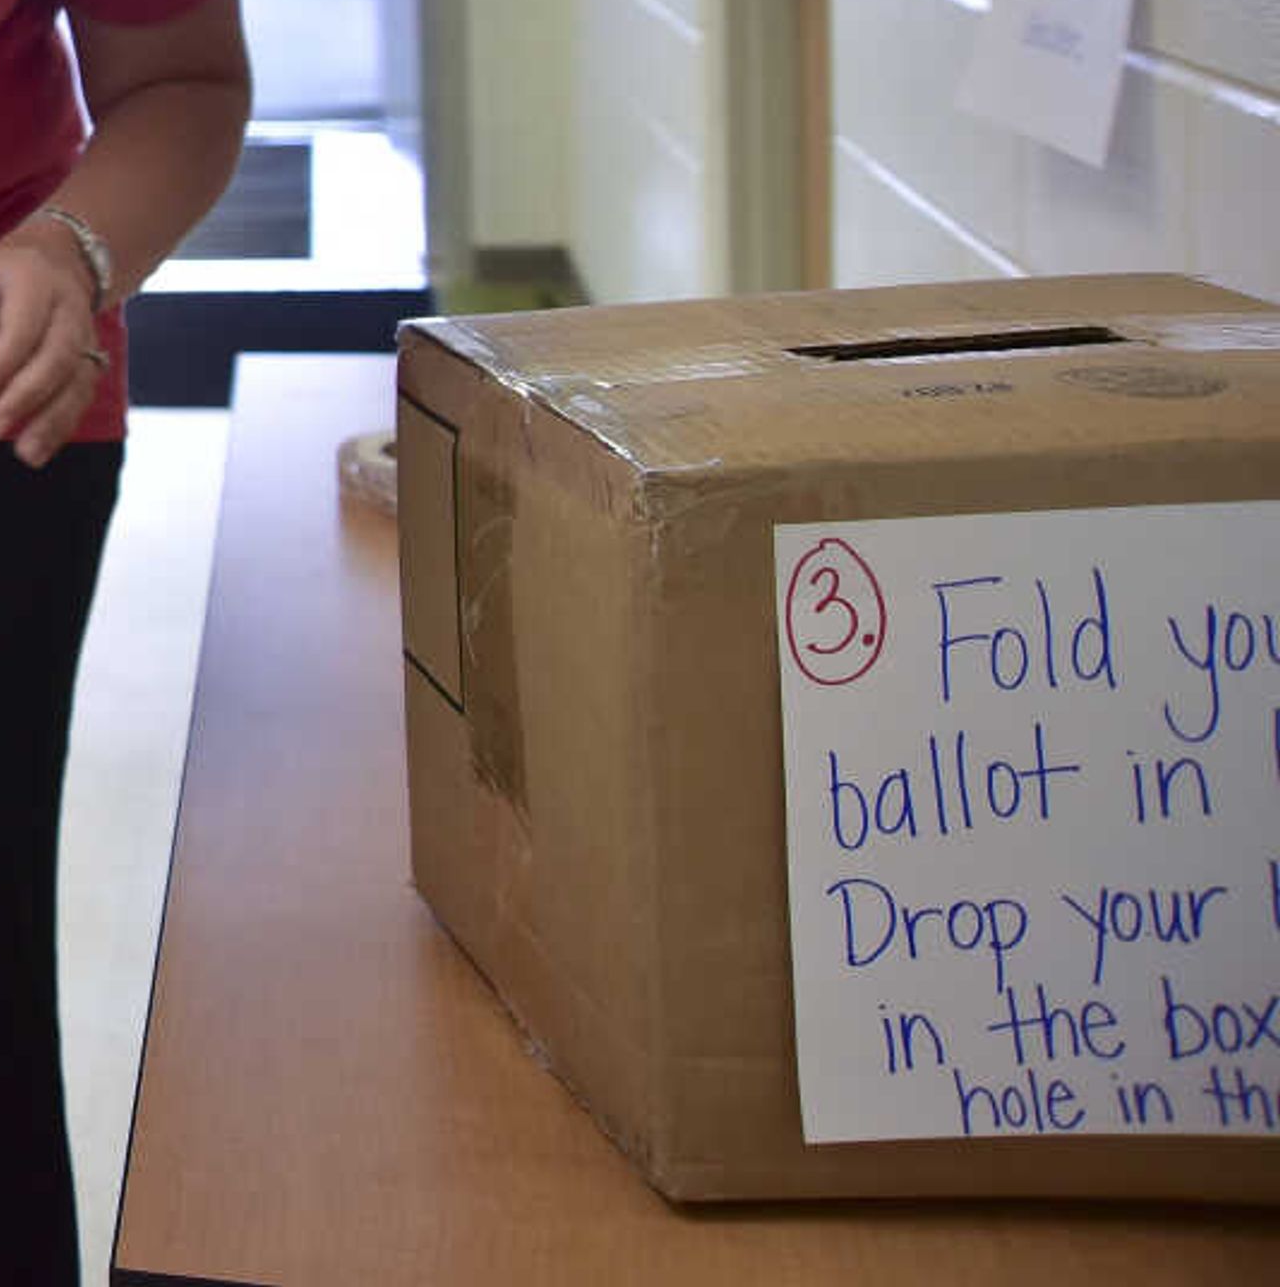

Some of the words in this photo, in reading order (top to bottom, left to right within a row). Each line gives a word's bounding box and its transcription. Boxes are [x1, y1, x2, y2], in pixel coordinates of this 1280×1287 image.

[807, 567, 876, 655] 3.
[932, 566, 1117, 703] Fold
[828, 722, 1080, 851] ballot
[1126, 748, 1213, 824] in
[826, 877, 1029, 994] Drop
[1061, 886, 1229, 985] your
[878, 1003, 945, 1074] in
[987, 983, 1126, 1066] the
[1160, 975, 1280, 1060] box
[953, 1068, 1087, 1135] hole
[1110, 1072, 1174, 1124] in
[1202, 1066, 1280, 1129] th
